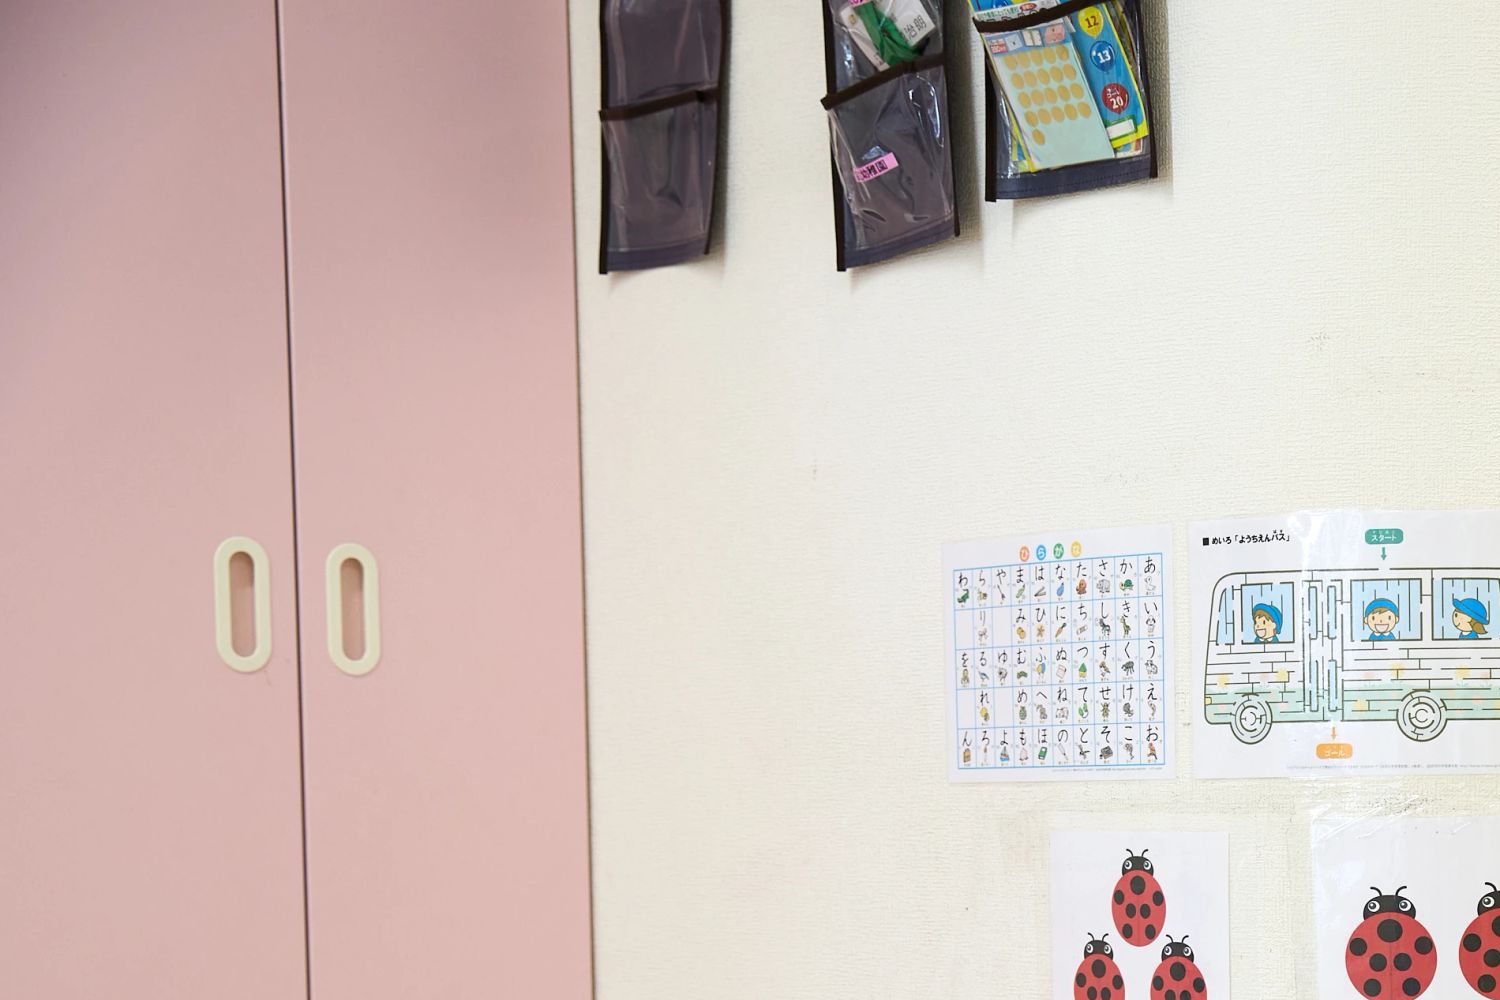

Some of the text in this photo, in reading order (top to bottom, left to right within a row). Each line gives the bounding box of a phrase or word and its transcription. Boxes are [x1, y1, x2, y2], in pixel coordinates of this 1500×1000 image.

[1085, 15, 1099, 29] 12
[1097, 50, 1111, 64] 13
[1110, 96, 1124, 110] 20
[1371, 534, 1397, 542] スタート
[959, 556, 1156, 587] わ ら や ま は な た さ か あ
[979, 600, 1158, 626] り み ひ に ち し き い
[961, 640, 1156, 668] を る ゆ む ふ ぬ つ す く う
[980, 682, 1157, 706] れ め へ ね て せ け え
[963, 724, 1158, 747] ん ろ よ も ほ の と そ こ お
